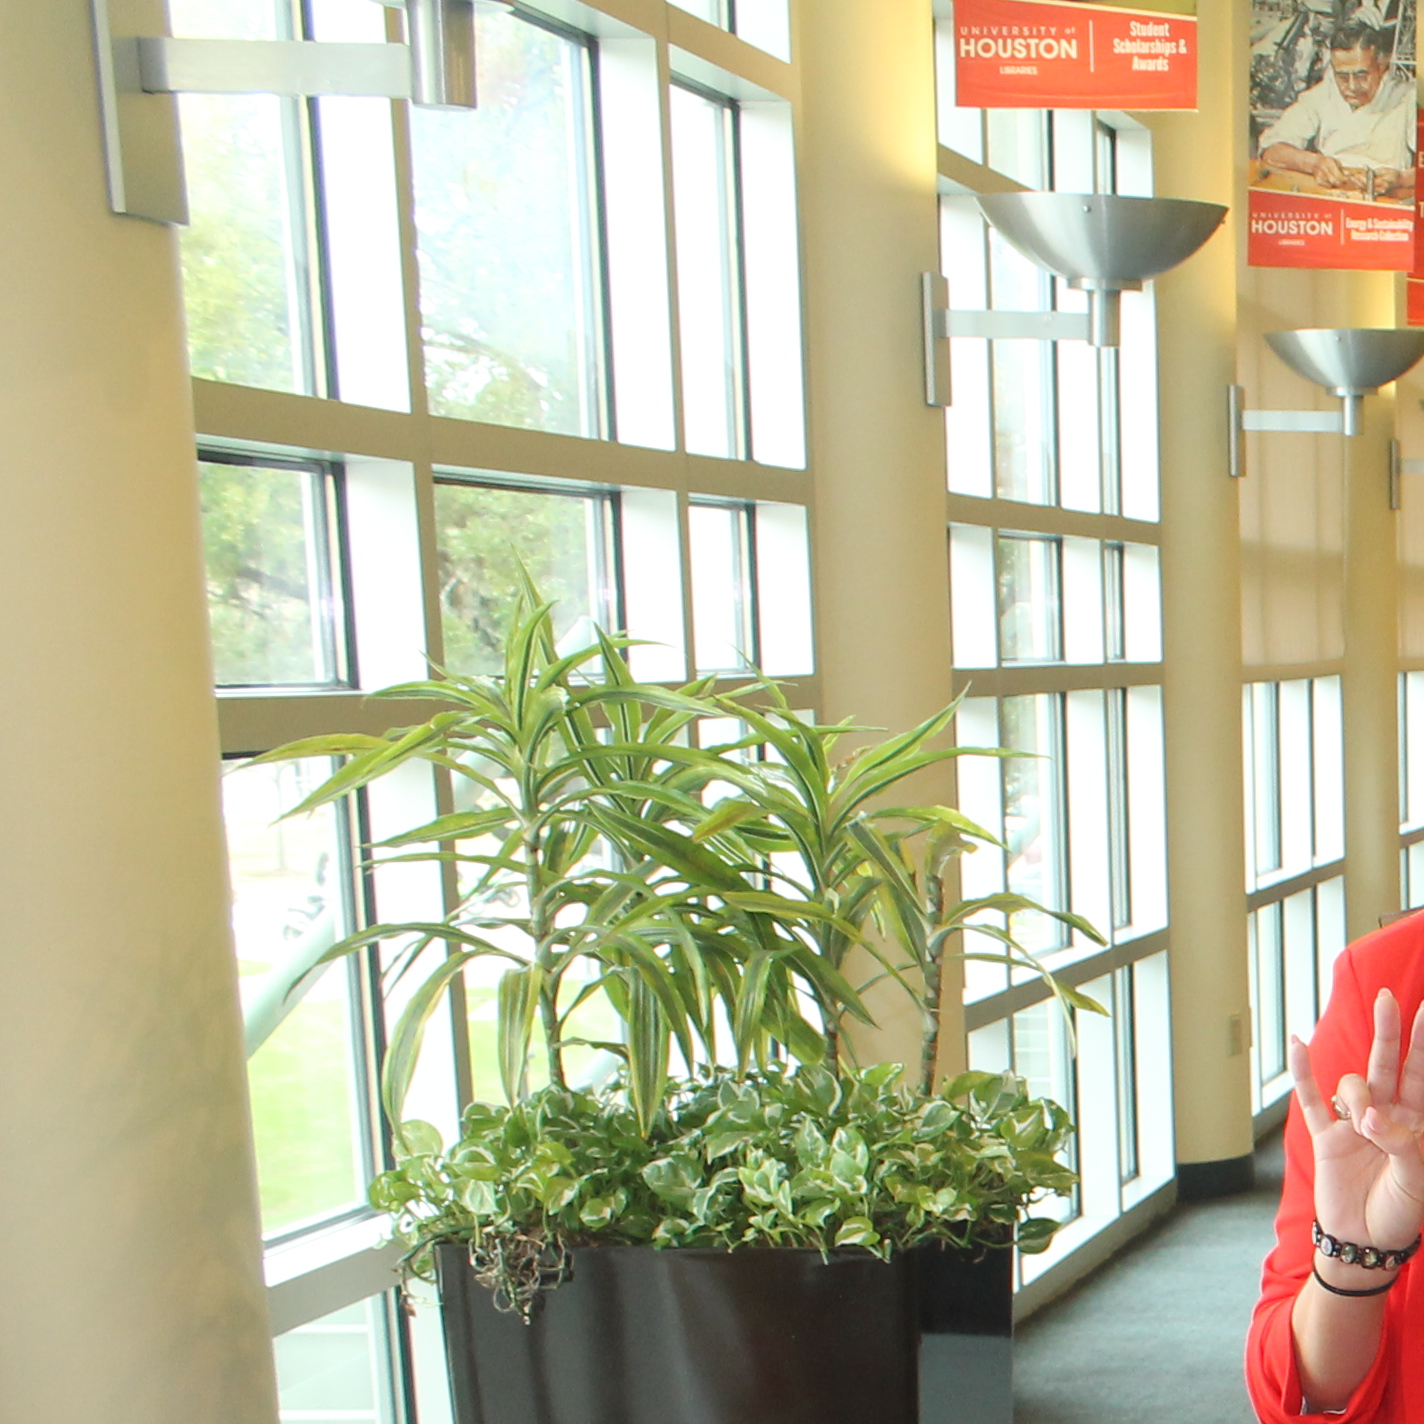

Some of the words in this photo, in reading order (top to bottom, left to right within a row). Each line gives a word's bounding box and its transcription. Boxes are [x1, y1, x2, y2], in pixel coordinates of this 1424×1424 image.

[960, 26, 1057, 36] UNIVERSITY
[1129, 21, 1170, 37] Student
[960, 37, 1078, 59] HOUSTON
[1113, 38, 1177, 57] Scholarships
[1178, 39, 1187, 54] &
[1000, 66, 1038, 75] LIBRARIES
[1131, 56, 1169, 71] Awards
[1252, 219, 1333, 236] HOUSTON
